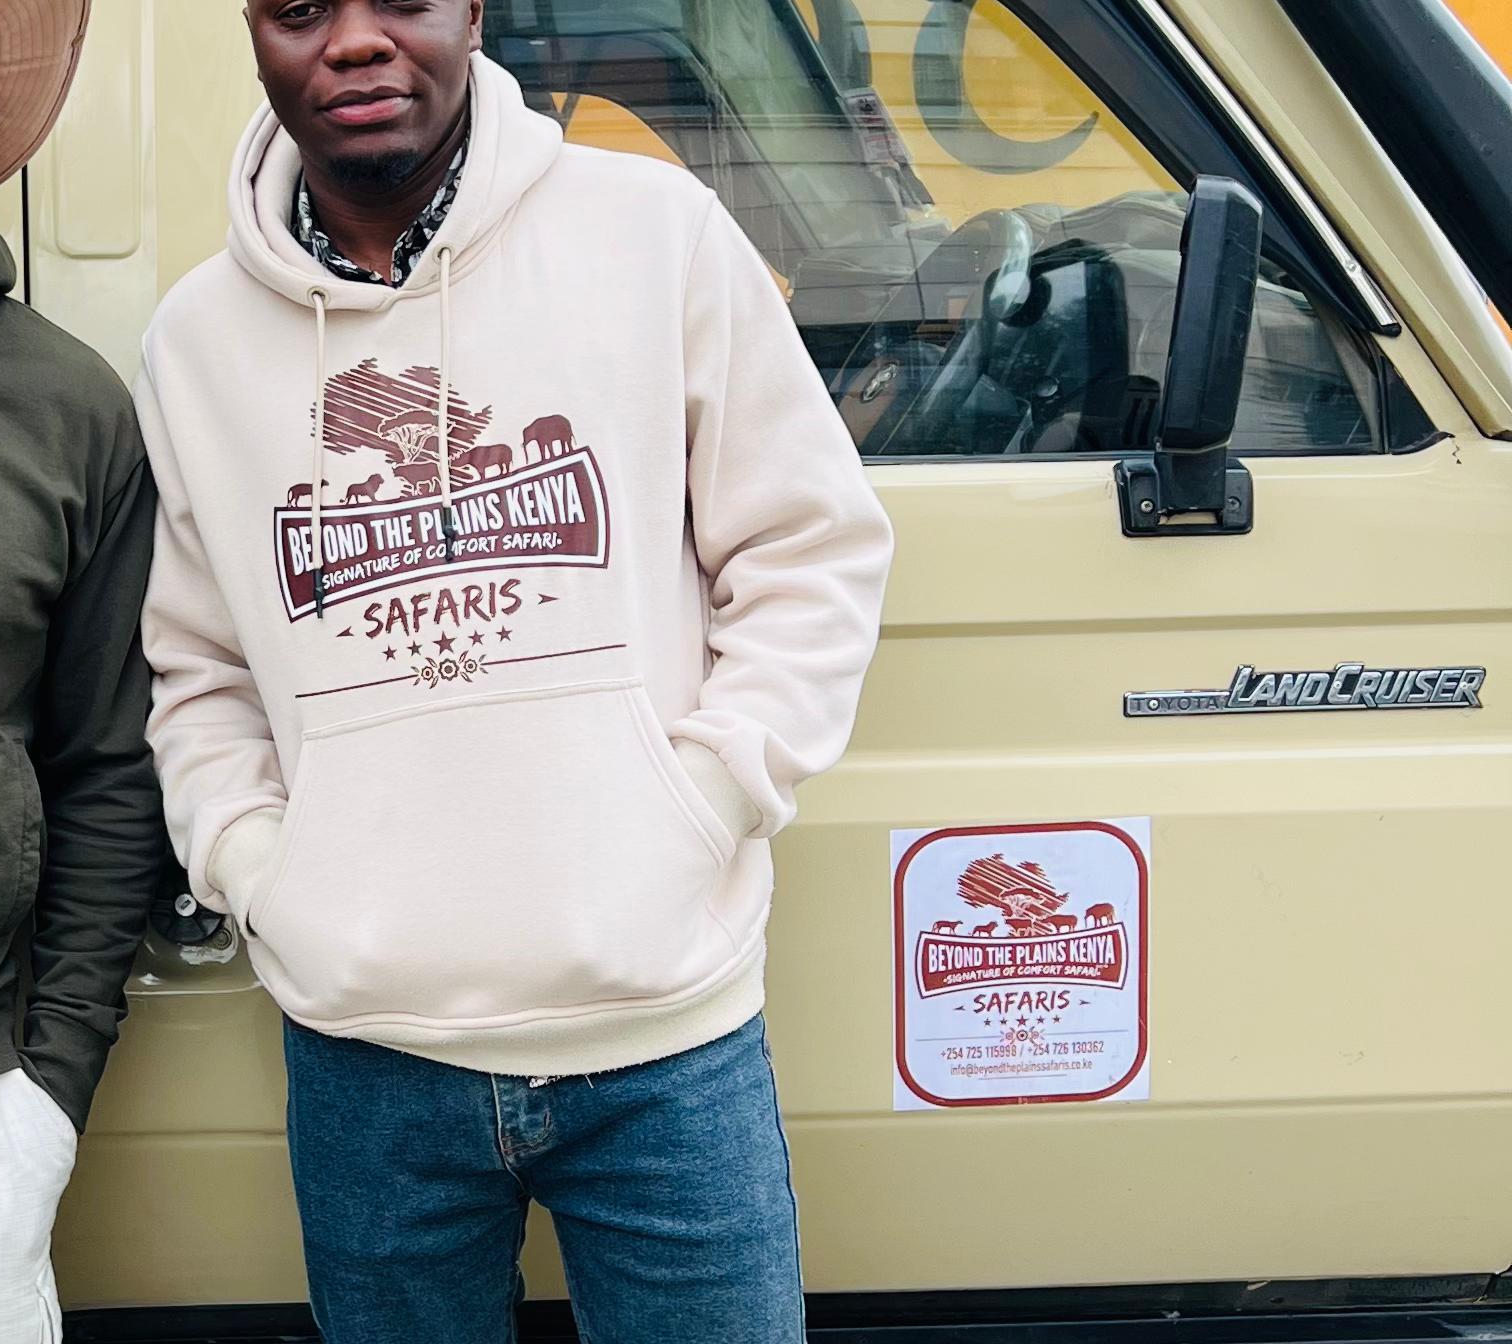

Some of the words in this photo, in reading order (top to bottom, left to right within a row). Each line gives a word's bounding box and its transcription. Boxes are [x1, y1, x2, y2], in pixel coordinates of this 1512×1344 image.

[287, 522, 369, 576] BEOND
[370, 514, 416, 551] THE
[418, 492, 504, 544] PLAINS
[506, 471, 586, 528] KENYA
[321, 552, 401, 590] SIGNATURE
[403, 546, 423, 565] OF
[363, 578, 523, 639] SAFARIS
[1131, 696, 1220, 713] TOYOTA
[928, 942, 983, 974] BEYOND
[986, 946, 1013, 966] THE
[1015, 940, 1067, 965] PLAINS
[1069, 934, 1116, 964] KENYA
[1002, 966, 1016, 976] OF
[1018, 965, 1063, 976] COMFORT
[973, 990, 1071, 1014] SAFARIS
[941, 1047, 963, 1060] +254
[966, 1046, 982, 1059] 725
[1028, 1042, 1050, 1056] +254
